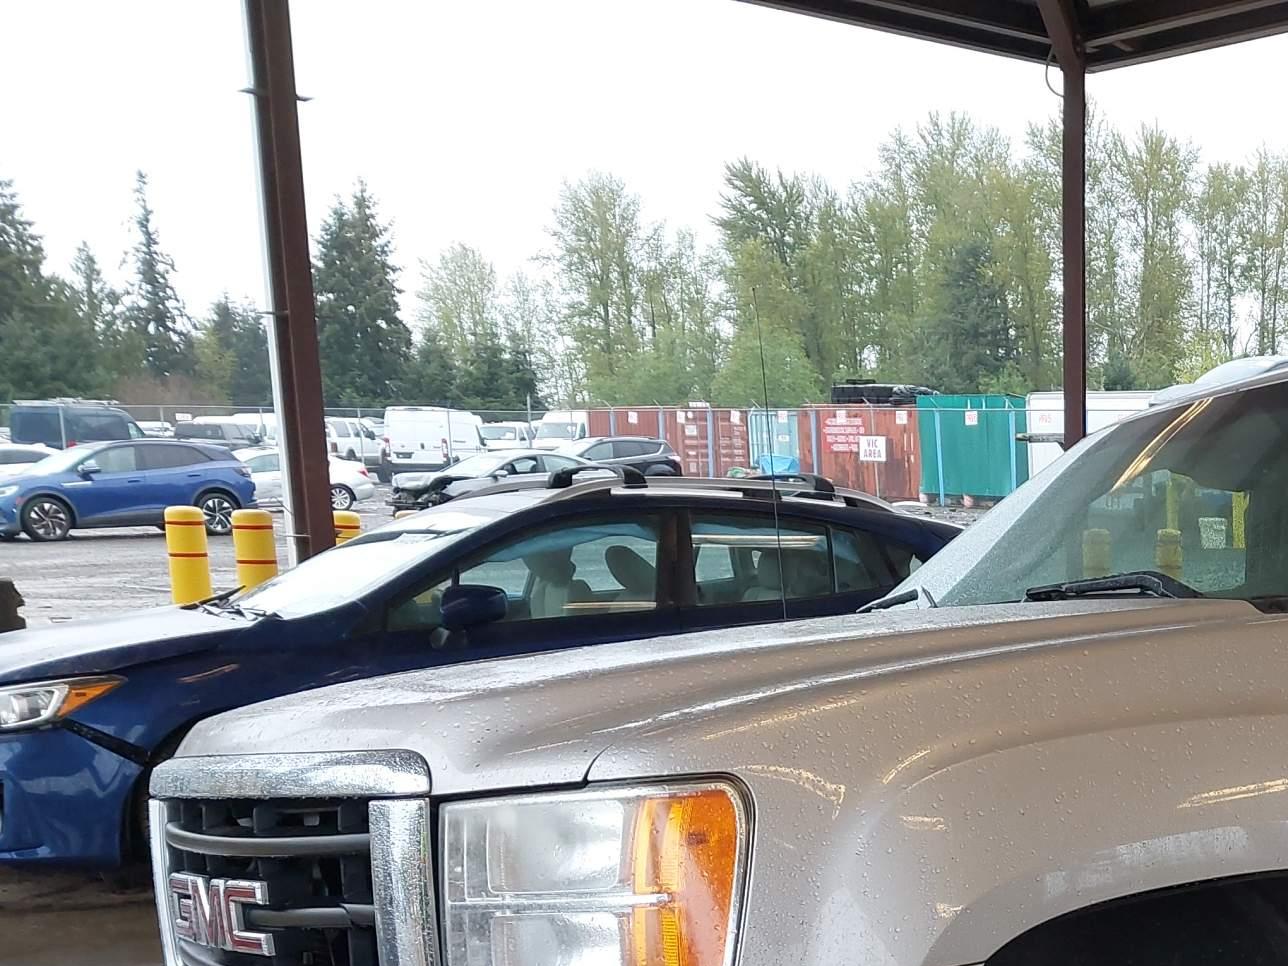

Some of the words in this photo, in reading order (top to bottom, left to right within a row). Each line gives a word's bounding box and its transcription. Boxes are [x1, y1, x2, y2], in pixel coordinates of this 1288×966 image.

[866, 439, 879, 449] VIC
[863, 449, 882, 459] AREA
[169, 871, 276, 957] GMC
